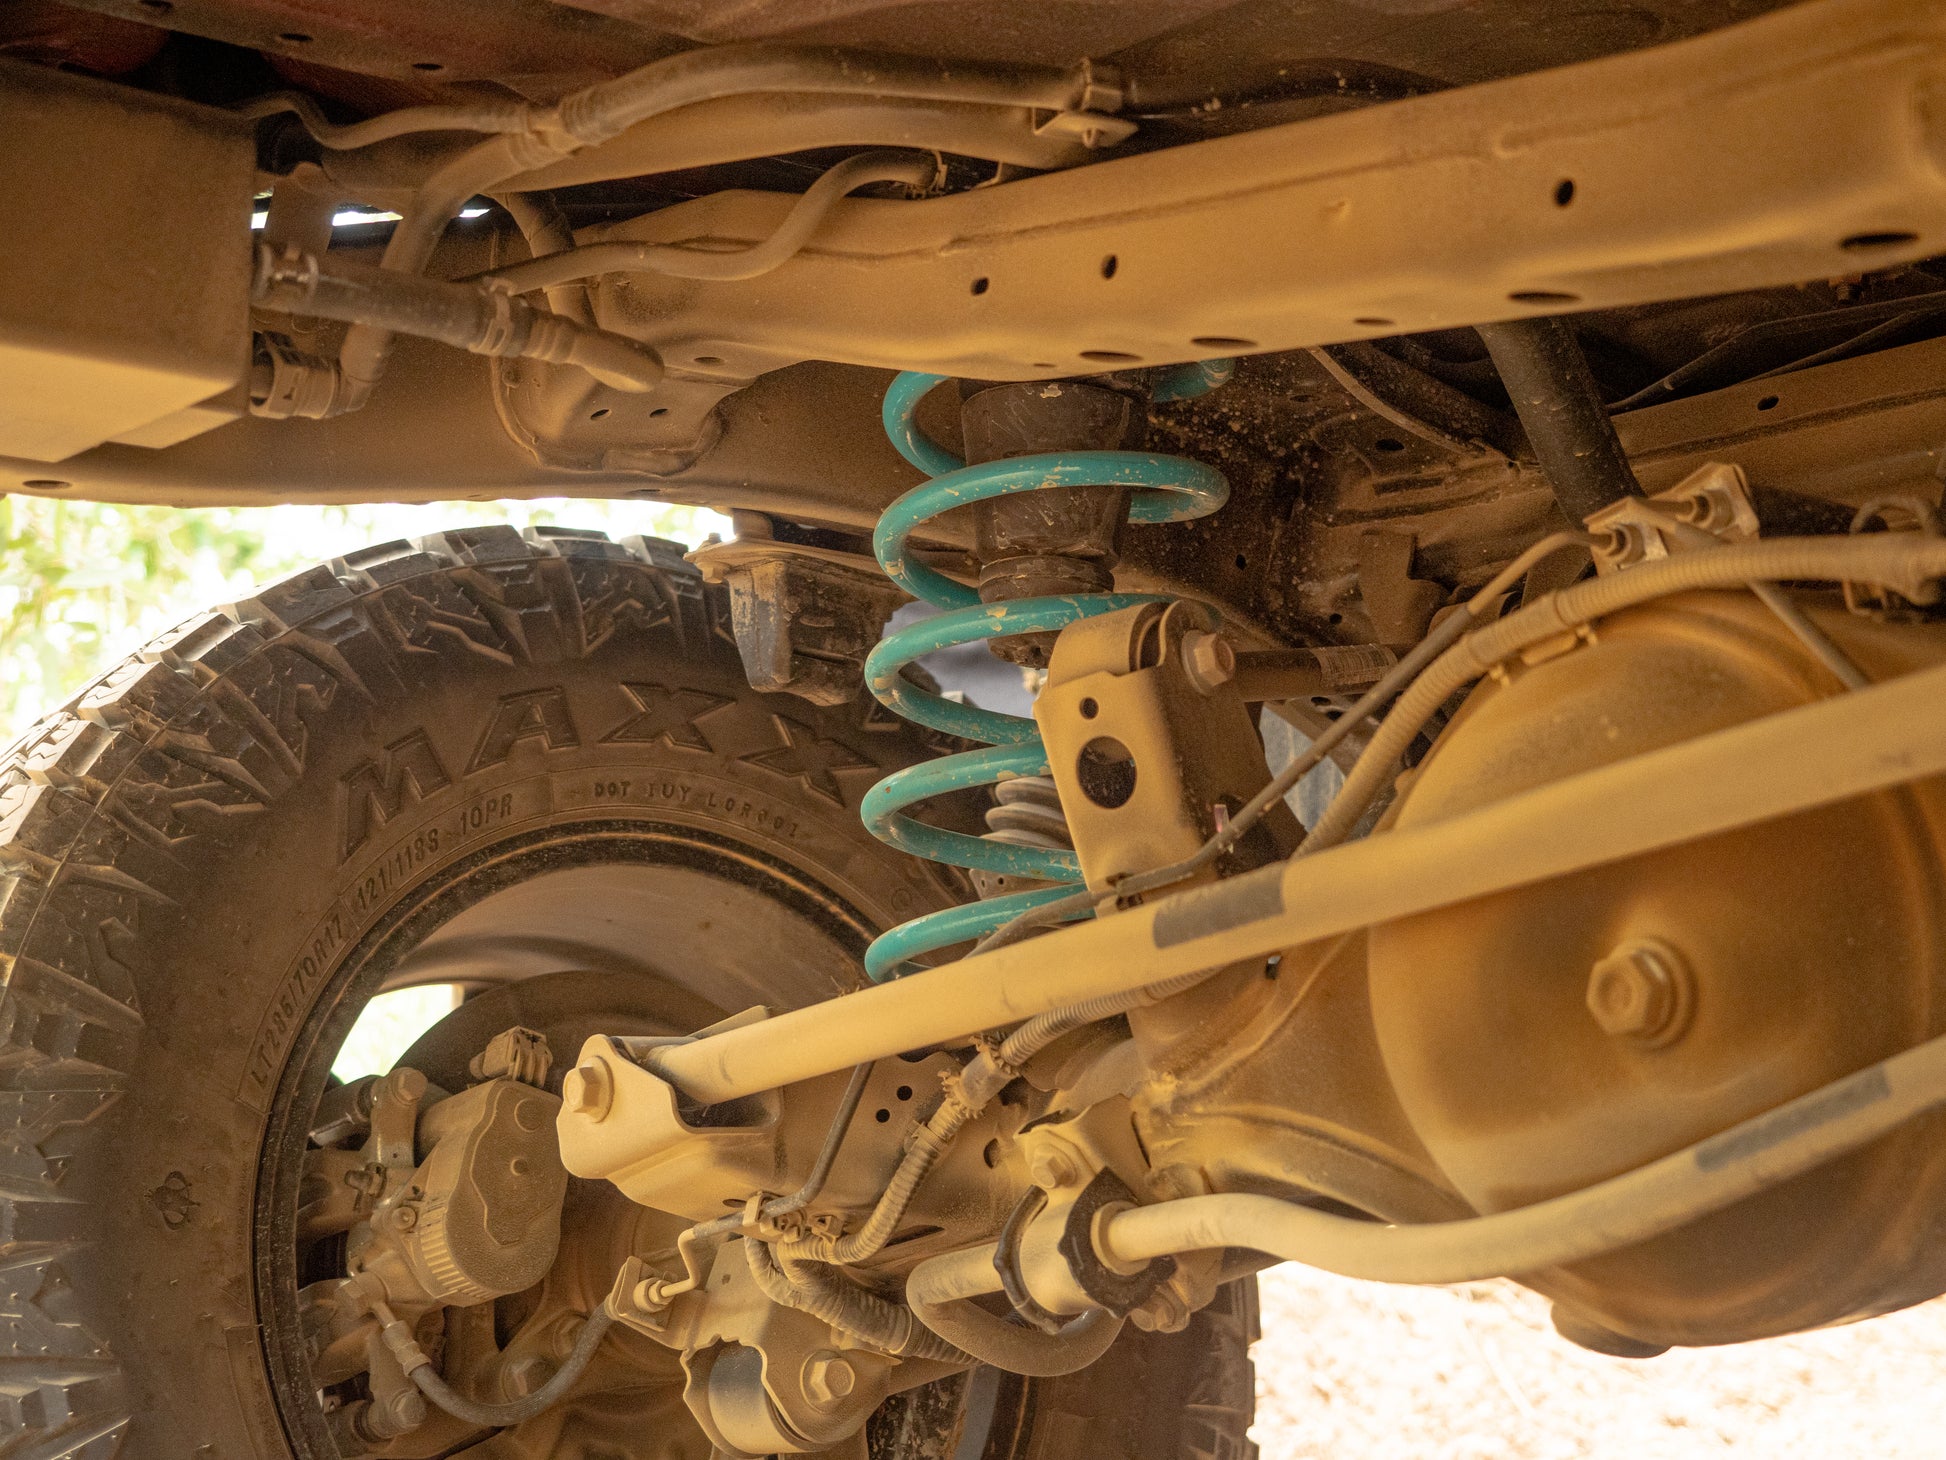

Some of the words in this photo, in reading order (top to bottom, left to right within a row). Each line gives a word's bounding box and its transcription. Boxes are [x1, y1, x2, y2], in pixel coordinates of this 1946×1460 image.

[337, 681, 970, 905] MAXX
[593, 780, 631, 798] DOT
[357, 828, 440, 911] 121/118S
[460, 792, 513, 836] 10PR
